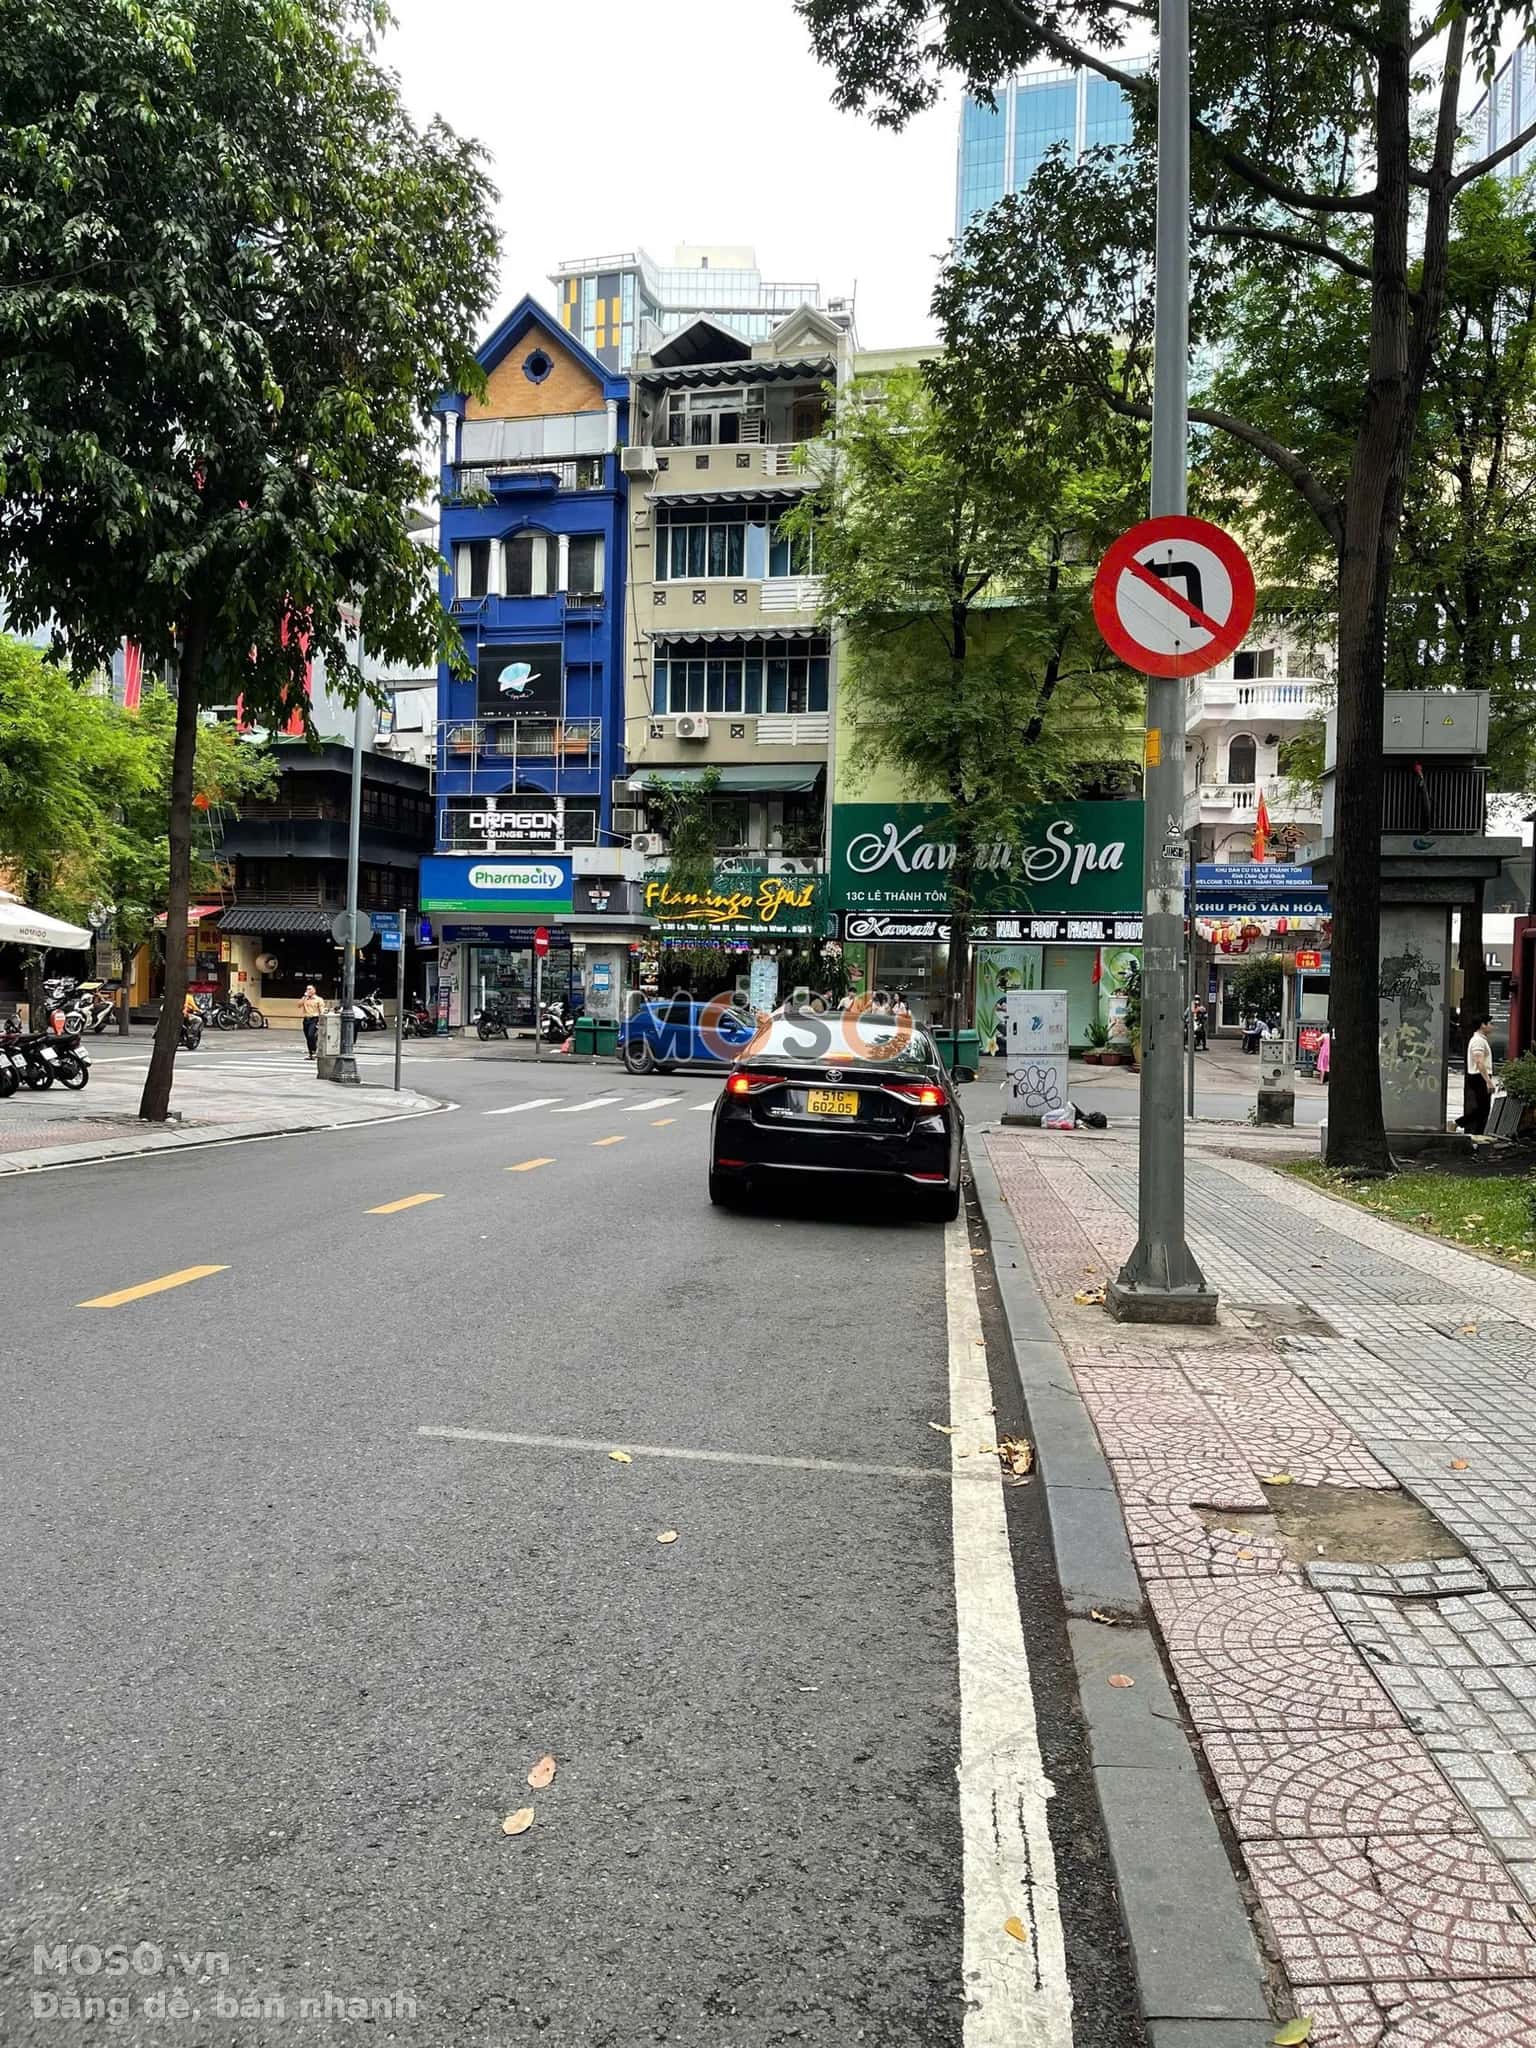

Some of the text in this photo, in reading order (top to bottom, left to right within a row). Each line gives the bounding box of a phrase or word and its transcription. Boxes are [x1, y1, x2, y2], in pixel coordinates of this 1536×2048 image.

[469, 812, 563, 829] DRAGON
[481, 830, 552, 839] LOUNGE BAR
[1022, 820, 1126, 885] Spa
[475, 868, 557, 886] Pharmacity
[846, 889, 947, 901] 13C LÊ THÁNH TÔN
[1195, 903, 1224, 912] KHU
[1293, 901, 1323, 912] HÓA
[849, 917, 937, 936] Kawaii
[996, 921, 1022, 938] NAIL
[1030, 921, 1058, 938] FOOT
[1067, 921, 1105, 939] FACIAL
[822, 1090, 844, 1101] 51G
[812, 1101, 852, 1113] 602.05
